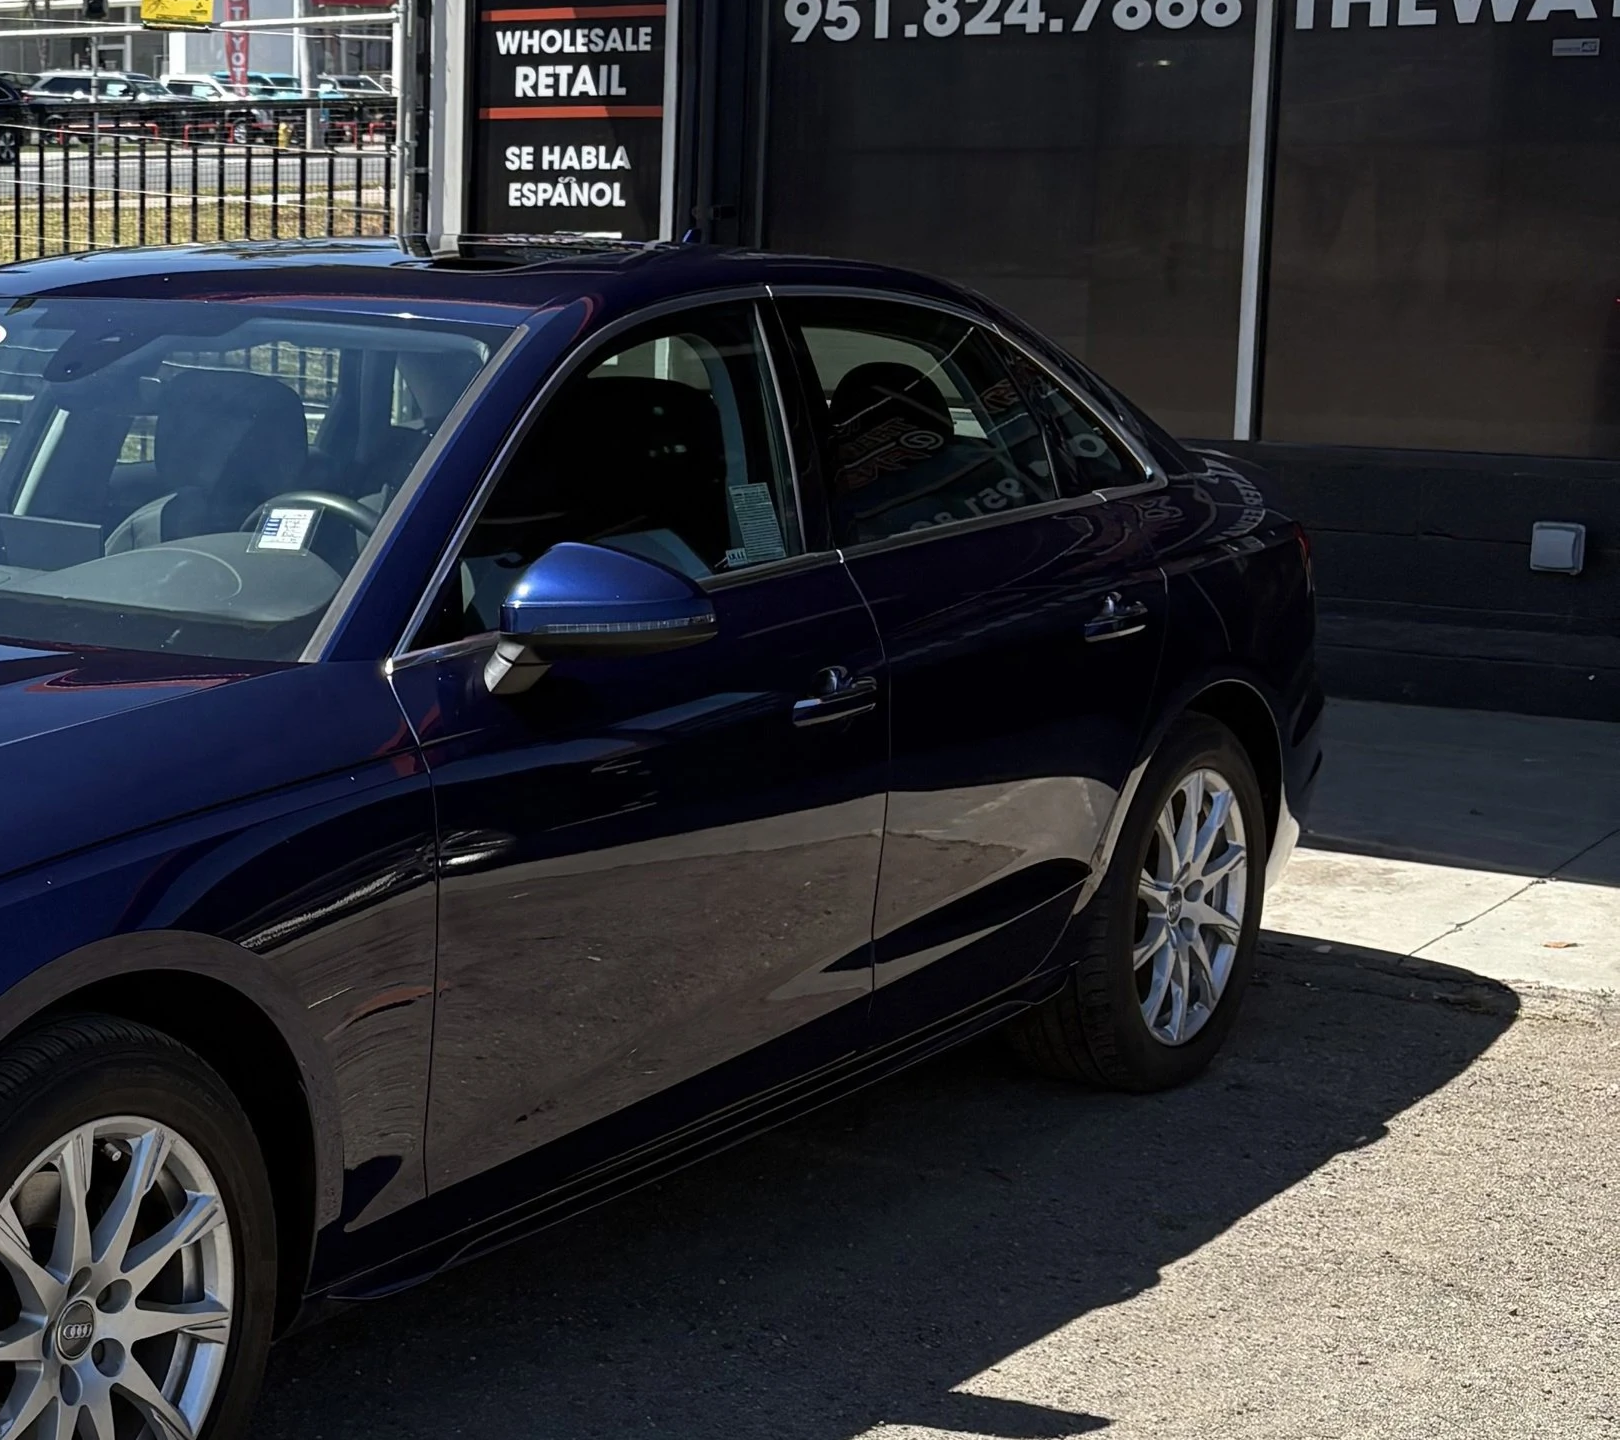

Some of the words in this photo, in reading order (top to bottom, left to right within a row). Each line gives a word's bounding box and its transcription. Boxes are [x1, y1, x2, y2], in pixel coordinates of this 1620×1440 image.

[495, 26, 652, 55] WHOLESALE
[514, 64, 627, 97] RETAIL
[505, 146, 534, 171] SE
[542, 145, 631, 171] HABLA
[508, 176, 626, 207] ESPAÑOL
